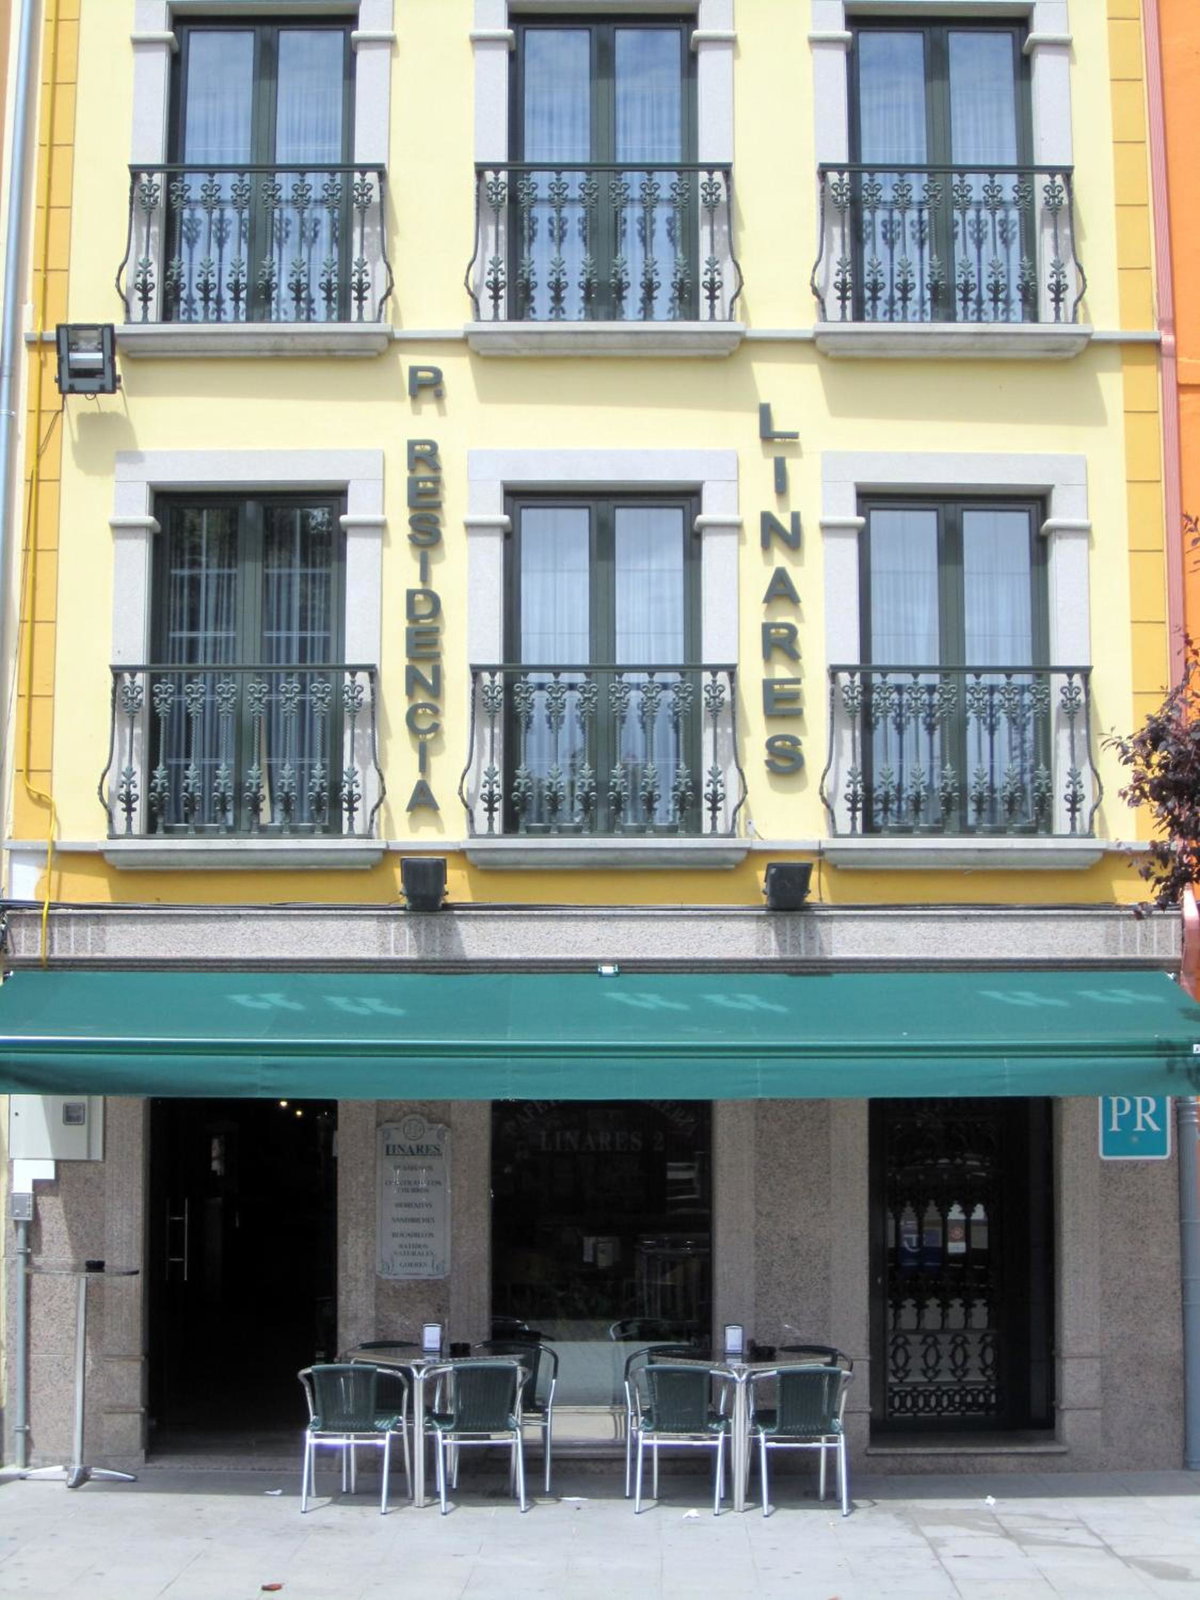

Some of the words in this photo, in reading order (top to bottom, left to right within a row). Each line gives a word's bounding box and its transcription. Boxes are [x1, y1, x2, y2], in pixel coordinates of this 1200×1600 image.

[407, 365, 444, 398] P.
[758, 402, 804, 775] LINARES
[405, 439, 443, 813] RESIDENCIA
[1108, 1095, 1161, 1132] PR
[385, 1143, 442, 1157] LINARES
[540, 1130, 643, 1152] LINARES
